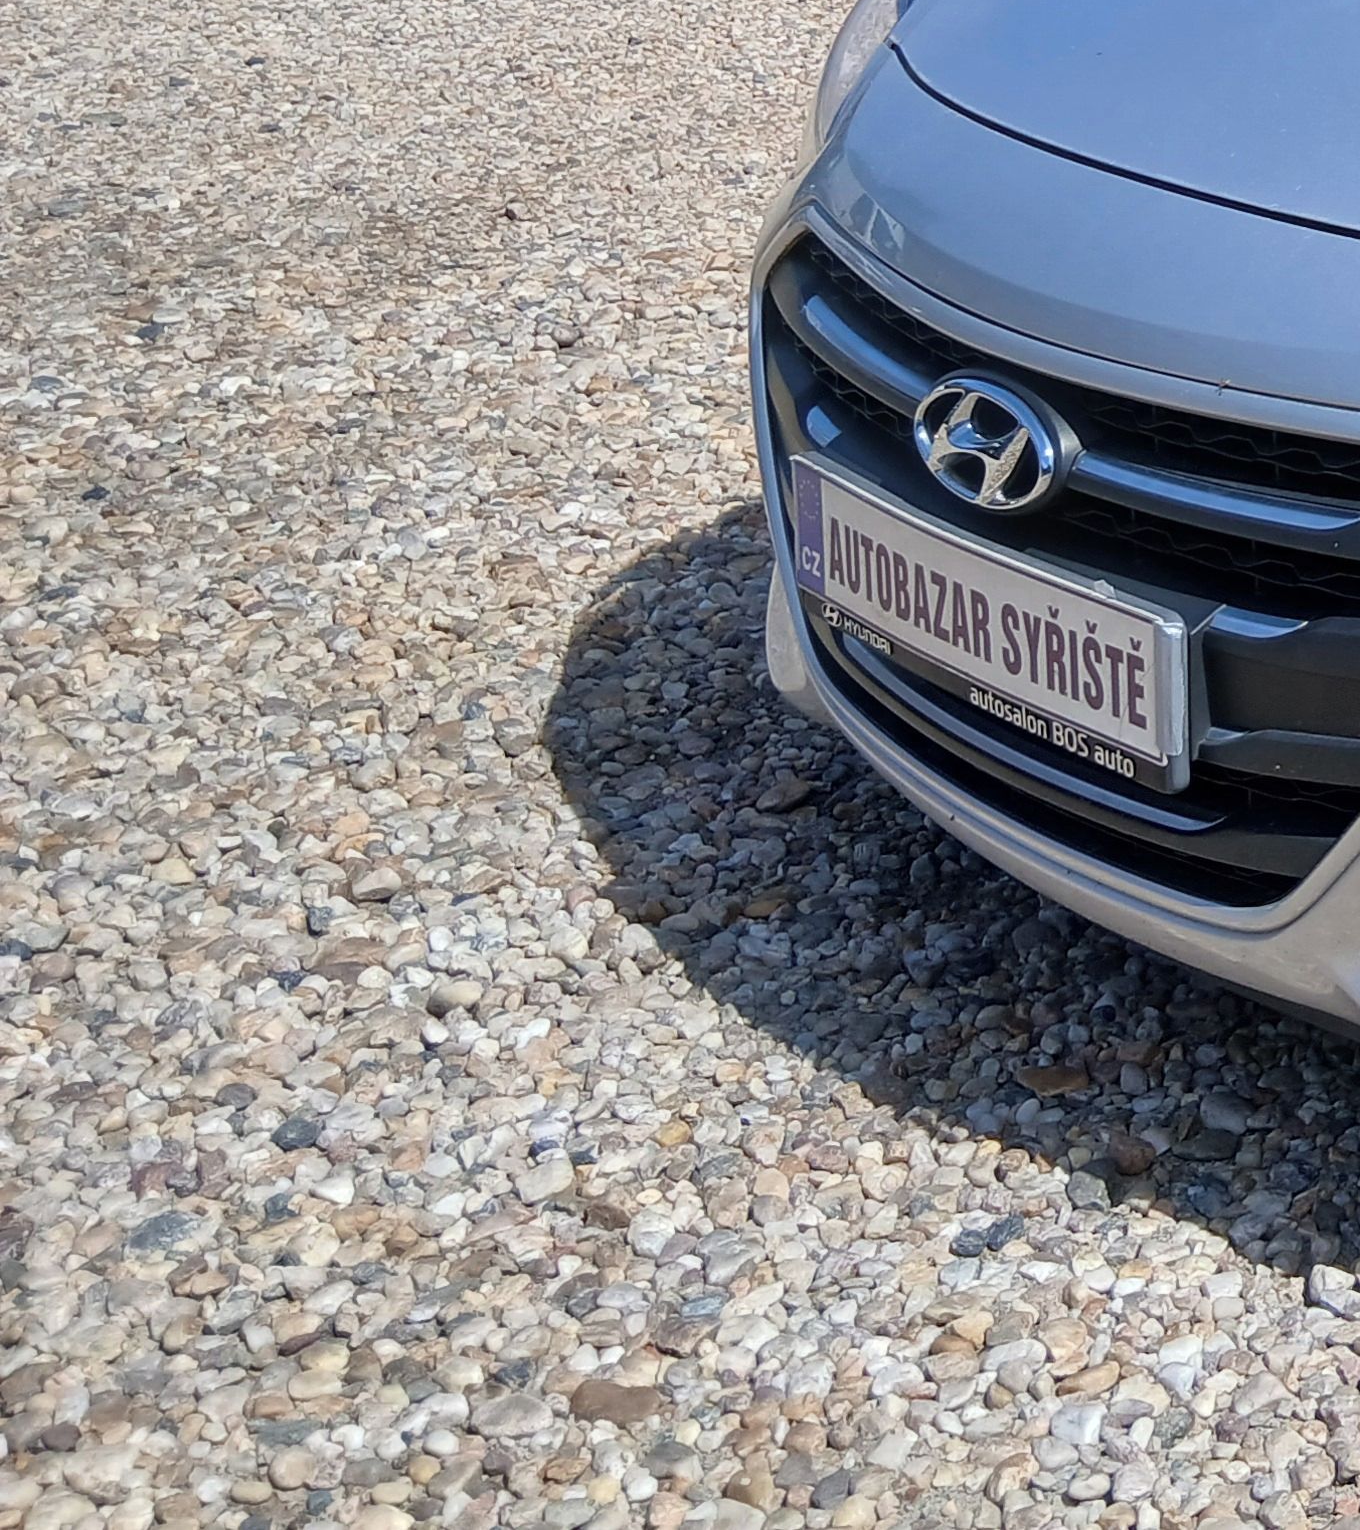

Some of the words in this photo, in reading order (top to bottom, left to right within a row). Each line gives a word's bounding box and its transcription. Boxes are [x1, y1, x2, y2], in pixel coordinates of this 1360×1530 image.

[801, 545, 822, 578] CZ
[829, 516, 993, 664] AUTOBAZAR
[1001, 602, 1148, 730] SYŘIŠTĚ
[843, 617, 892, 656] HYUNDAI
[969, 686, 1048, 740] autosalon
[1052, 723, 1090, 758] BOS
[1094, 742, 1135, 779] auto
